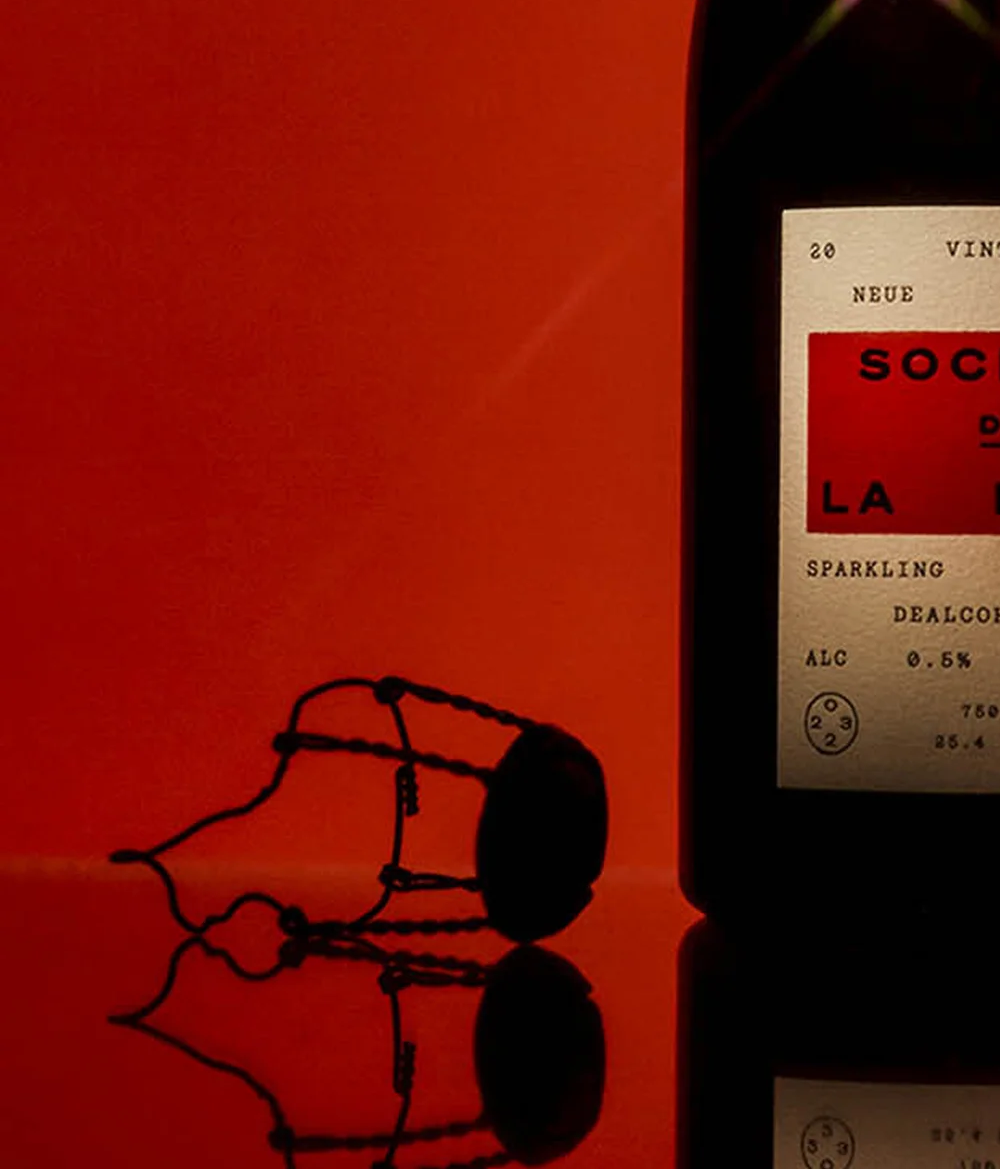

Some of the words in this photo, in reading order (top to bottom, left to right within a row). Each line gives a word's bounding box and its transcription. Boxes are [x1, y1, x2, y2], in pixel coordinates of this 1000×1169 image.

[810, 242, 836, 260] 20
[853, 285, 913, 303] NEUE
[823, 481, 893, 515] LA
[807, 559, 944, 578] SPARKLING
[805, 649, 847, 667] ALC
[906, 650, 971, 669] 0.5%
[962, 704, 999, 719] 750
[935, 734, 985, 750] 25.4
